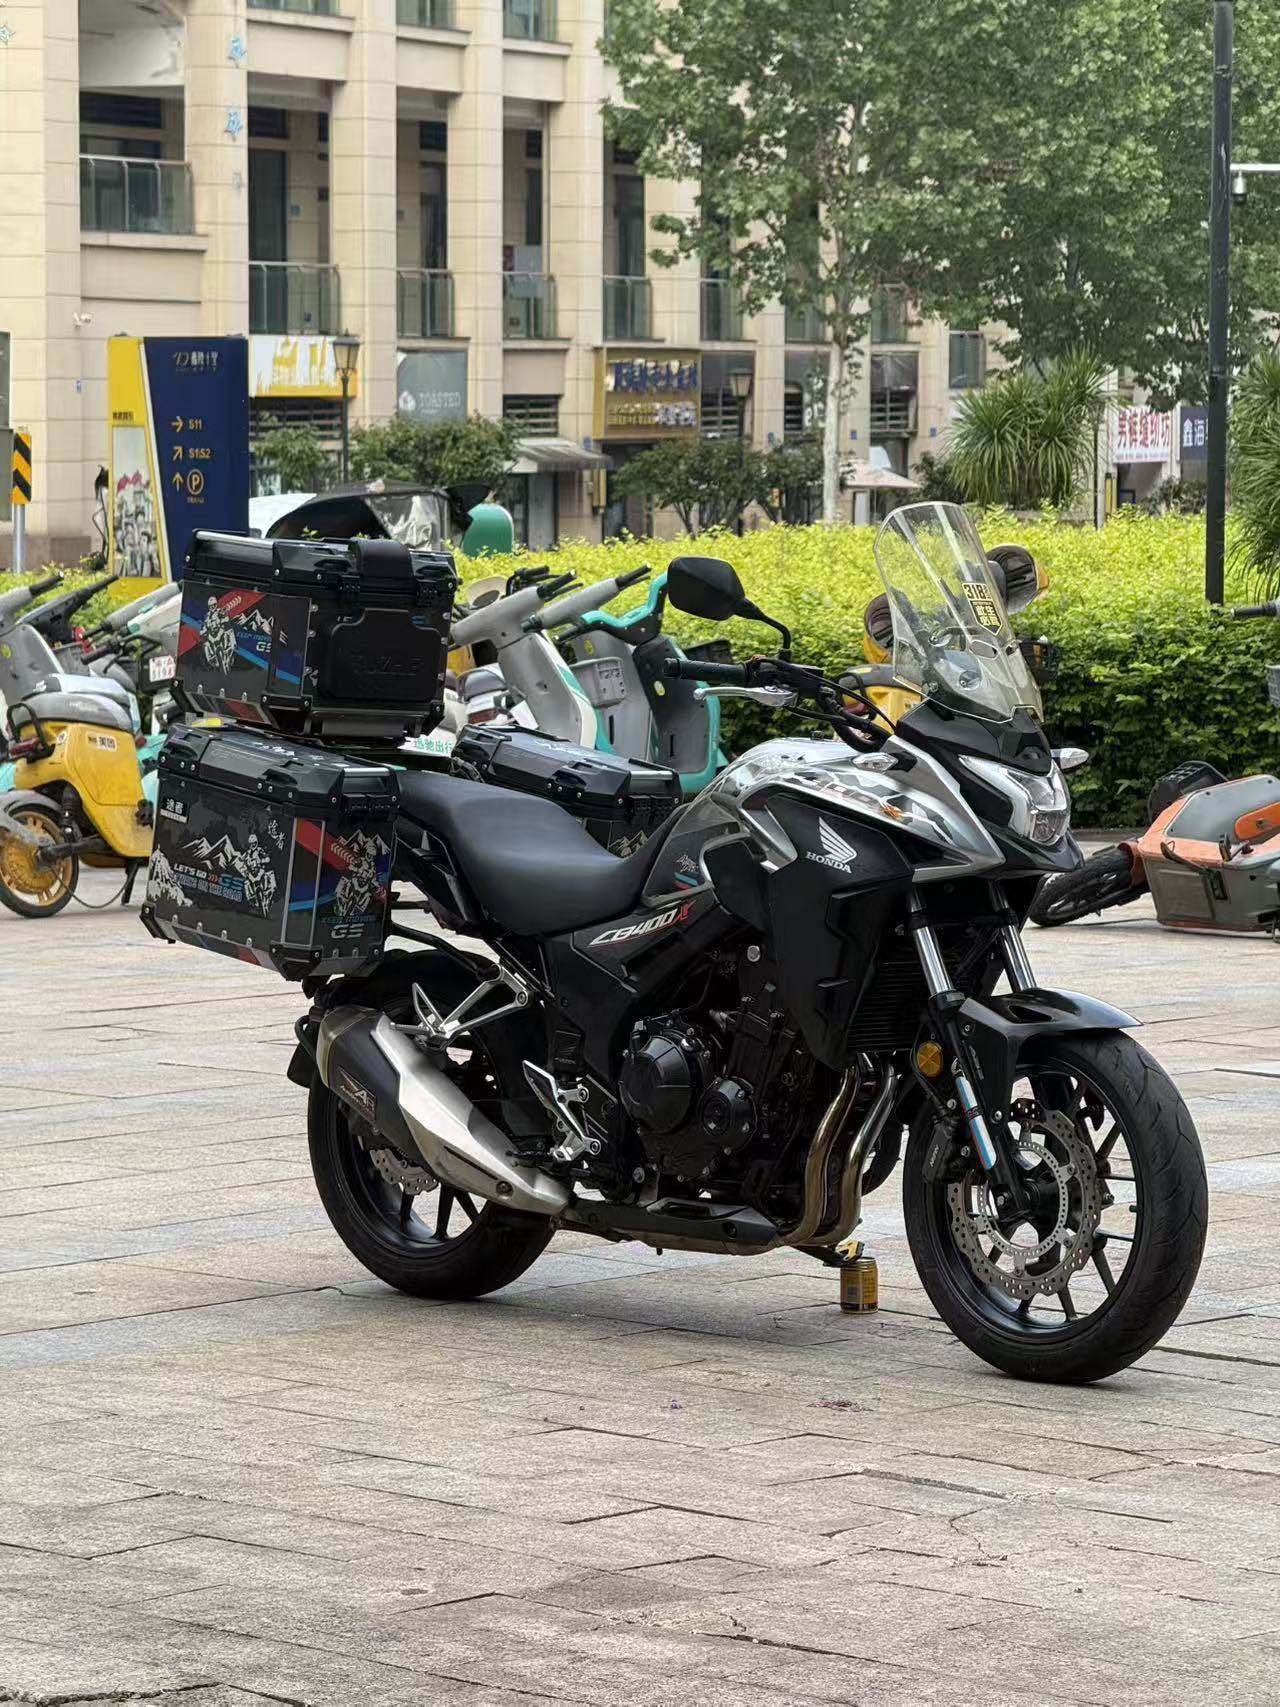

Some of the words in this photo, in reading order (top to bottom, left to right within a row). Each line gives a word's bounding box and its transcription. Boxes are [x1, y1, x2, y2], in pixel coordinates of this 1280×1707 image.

[1183, 418, 1209, 447] 鑫海
[963, 584, 987, 600] 318
[806, 851, 852, 873] HONDA
[588, 899, 697, 947] CB400X
